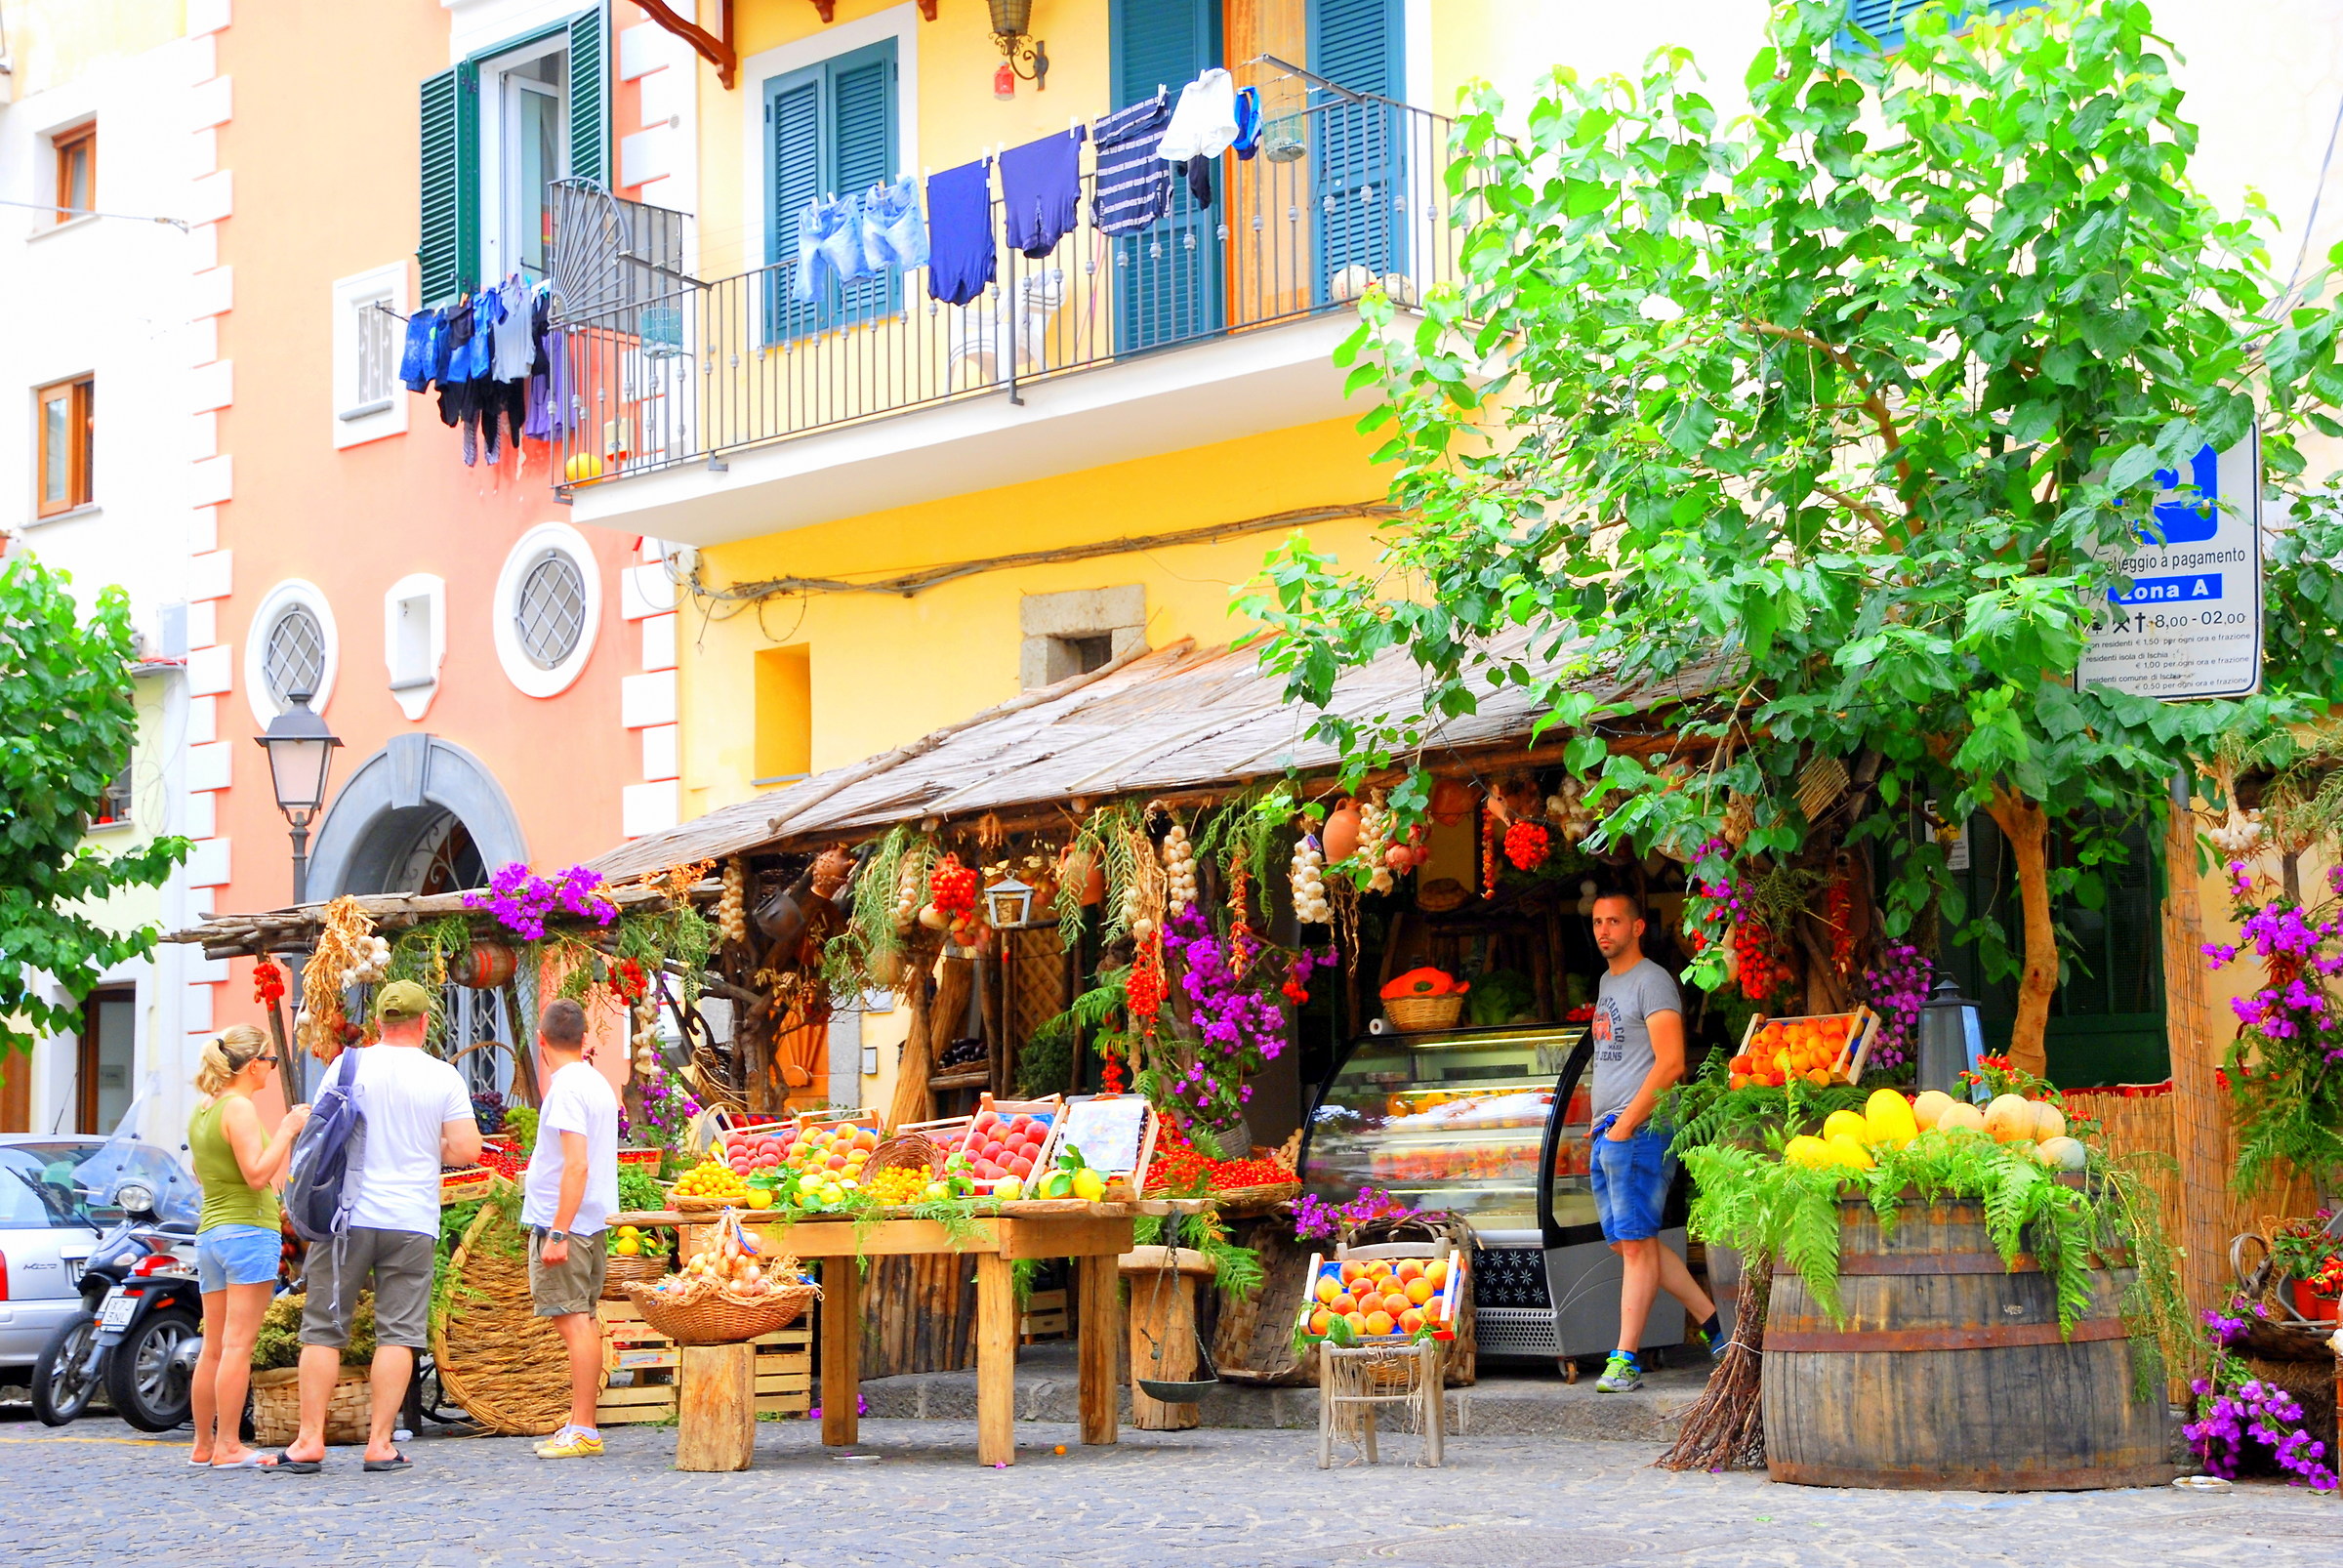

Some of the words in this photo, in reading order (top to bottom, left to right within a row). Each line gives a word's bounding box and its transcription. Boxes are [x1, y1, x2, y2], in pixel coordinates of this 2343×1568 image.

[2160, 556, 2168, 567] a
[2172, 548, 2245, 570] pagamento
[2192, 578, 2209, 597] A
[2101, 640, 2133, 648] residenti
[2085, 654, 2117, 663] residenti
[2177, 659, 2195, 668] ogni
[2085, 675, 2117, 683] residenti
[2118, 674, 2148, 682] comune
[2177, 680, 2194, 688] ogni
[2216, 677, 2248, 685] frazione
